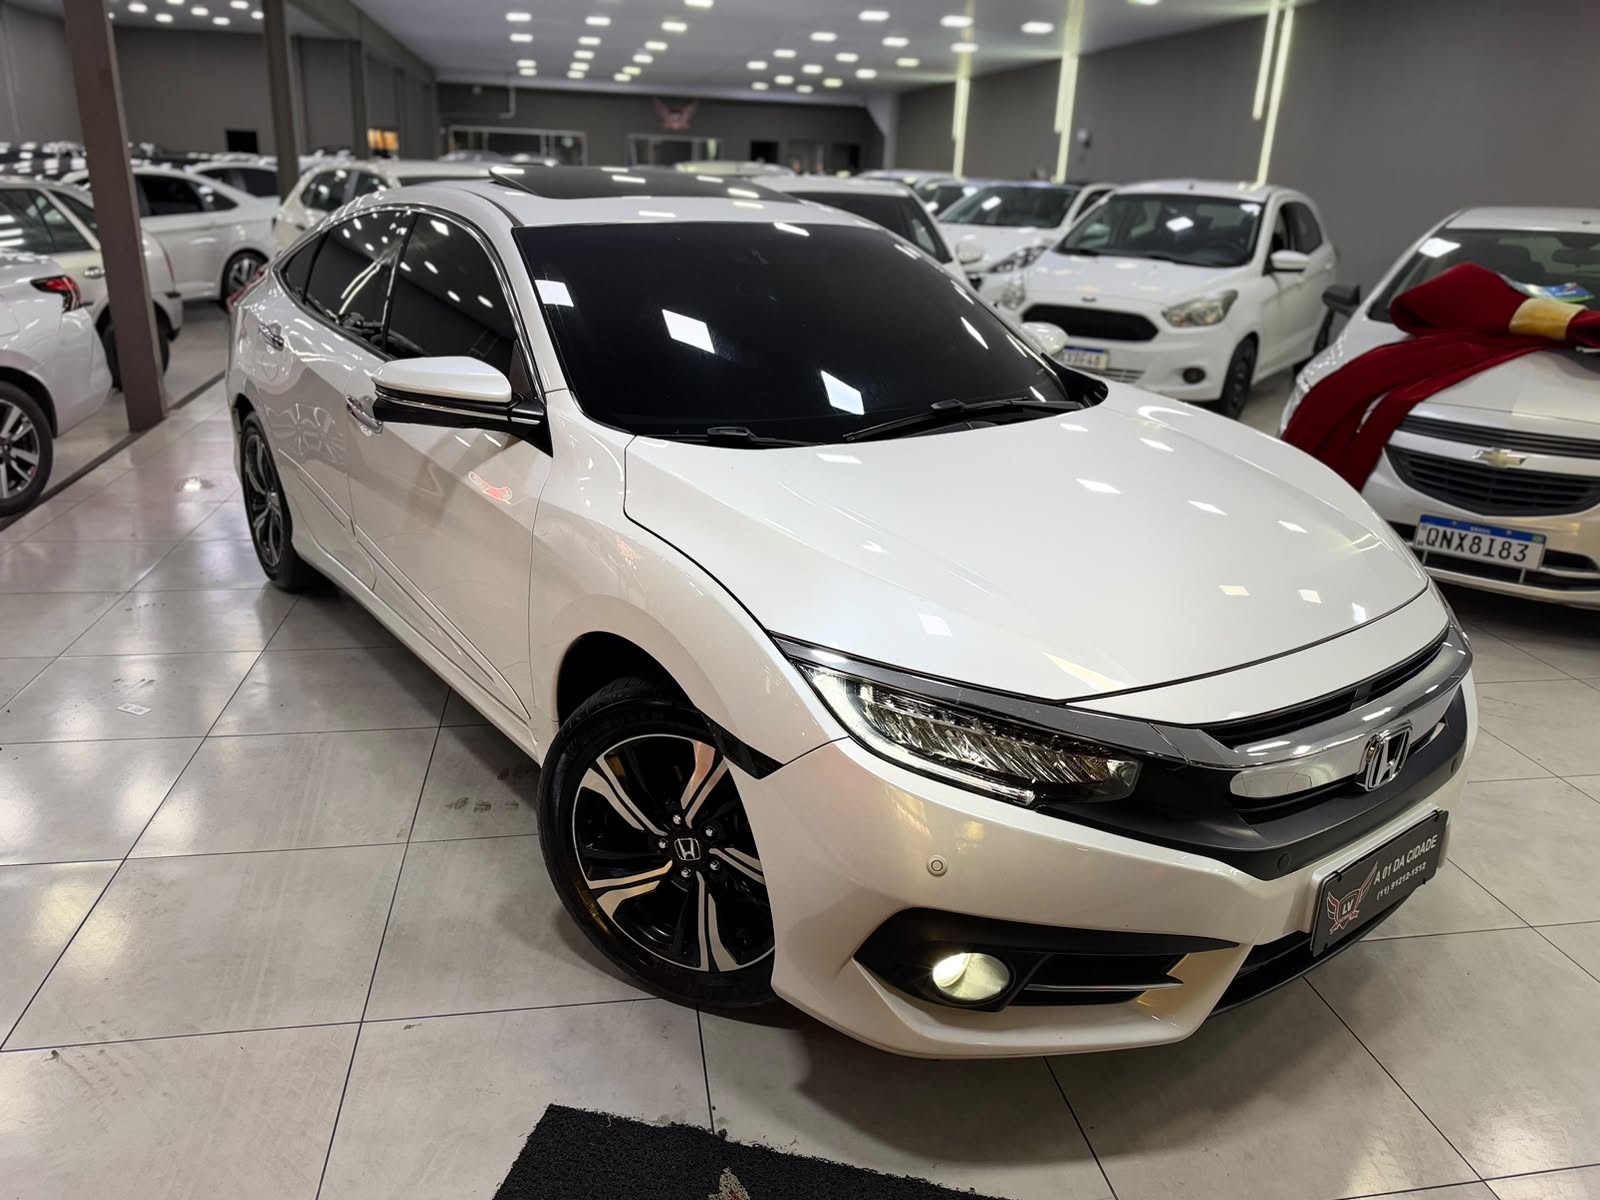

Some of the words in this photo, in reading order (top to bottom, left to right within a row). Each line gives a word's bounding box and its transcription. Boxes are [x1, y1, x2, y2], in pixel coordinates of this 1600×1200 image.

[1425, 527, 1529, 562] QNX8I83
[1374, 871, 1381, 885] A
[1382, 863, 1392, 879] 01
[1393, 855, 1405, 872] DA
[1407, 834, 1438, 863] CIDADE
[1343, 899, 1353, 915] LV
